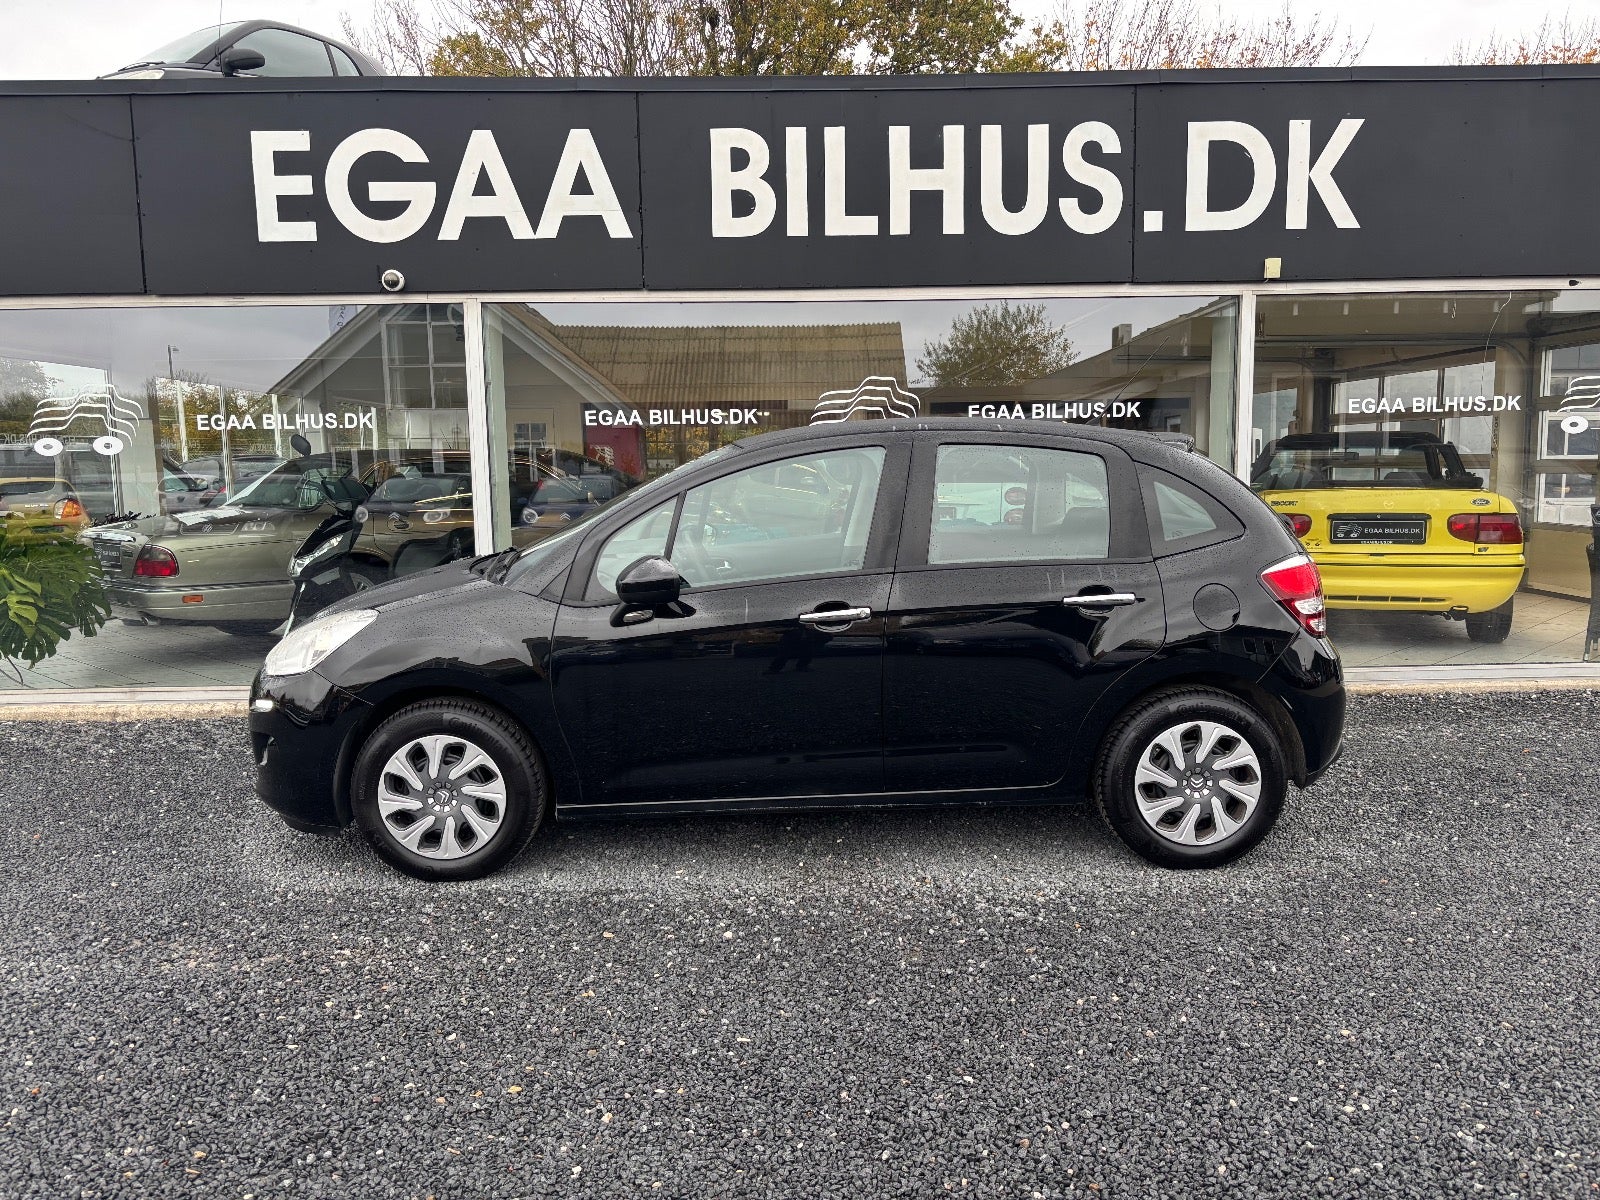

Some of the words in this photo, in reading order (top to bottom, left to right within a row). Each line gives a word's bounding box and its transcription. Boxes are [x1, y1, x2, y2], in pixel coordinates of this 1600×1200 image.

[250, 127, 633, 244] EGAA
[709, 118, 1366, 238] BILHUS.DK
[968, 404, 1026, 420] EGAA
[1031, 401, 1141, 419] BILHUS.DK
[1348, 397, 1406, 414] EGAA
[1412, 395, 1522, 413] BILHUS.DK
[196, 414, 257, 431] EGAA
[262, 412, 374, 430] BILHUS.DK
[584, 409, 644, 426] EGAA
[649, 408, 758, 425] BILHUS.DK
